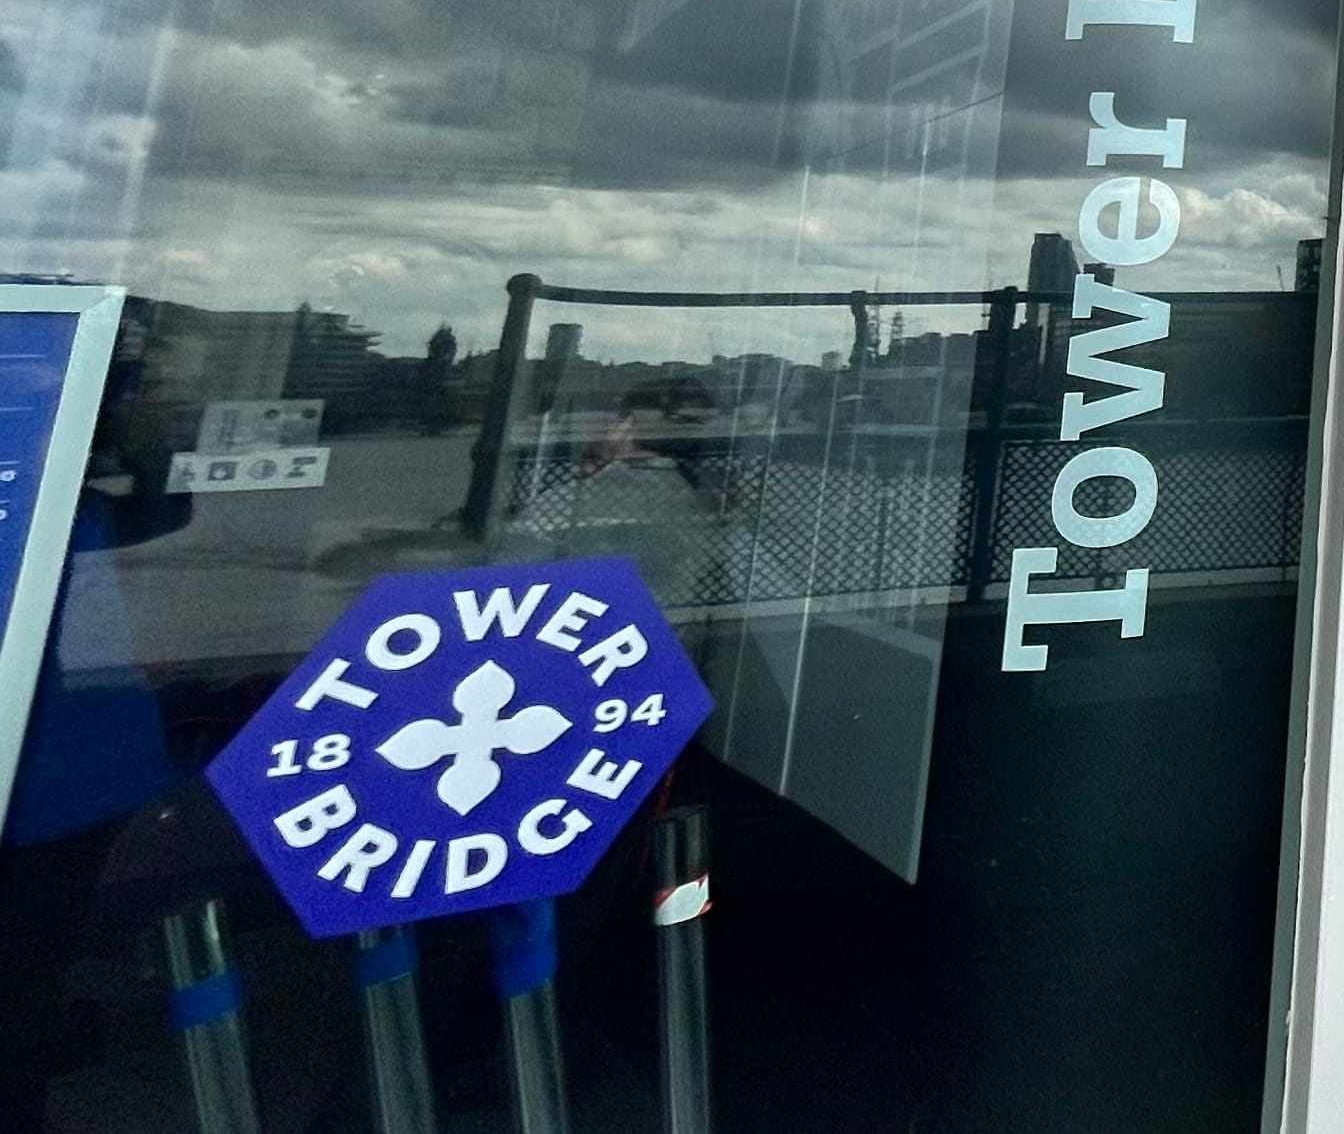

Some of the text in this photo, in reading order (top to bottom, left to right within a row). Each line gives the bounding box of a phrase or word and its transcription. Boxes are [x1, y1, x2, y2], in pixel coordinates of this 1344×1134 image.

[1001, 90, 1188, 672] Tower
[295, 583, 648, 712] TOWER
[266, 733, 352, 778] 18
[593, 693, 667, 734] 94
[274, 748, 643, 899] BRIDGE
